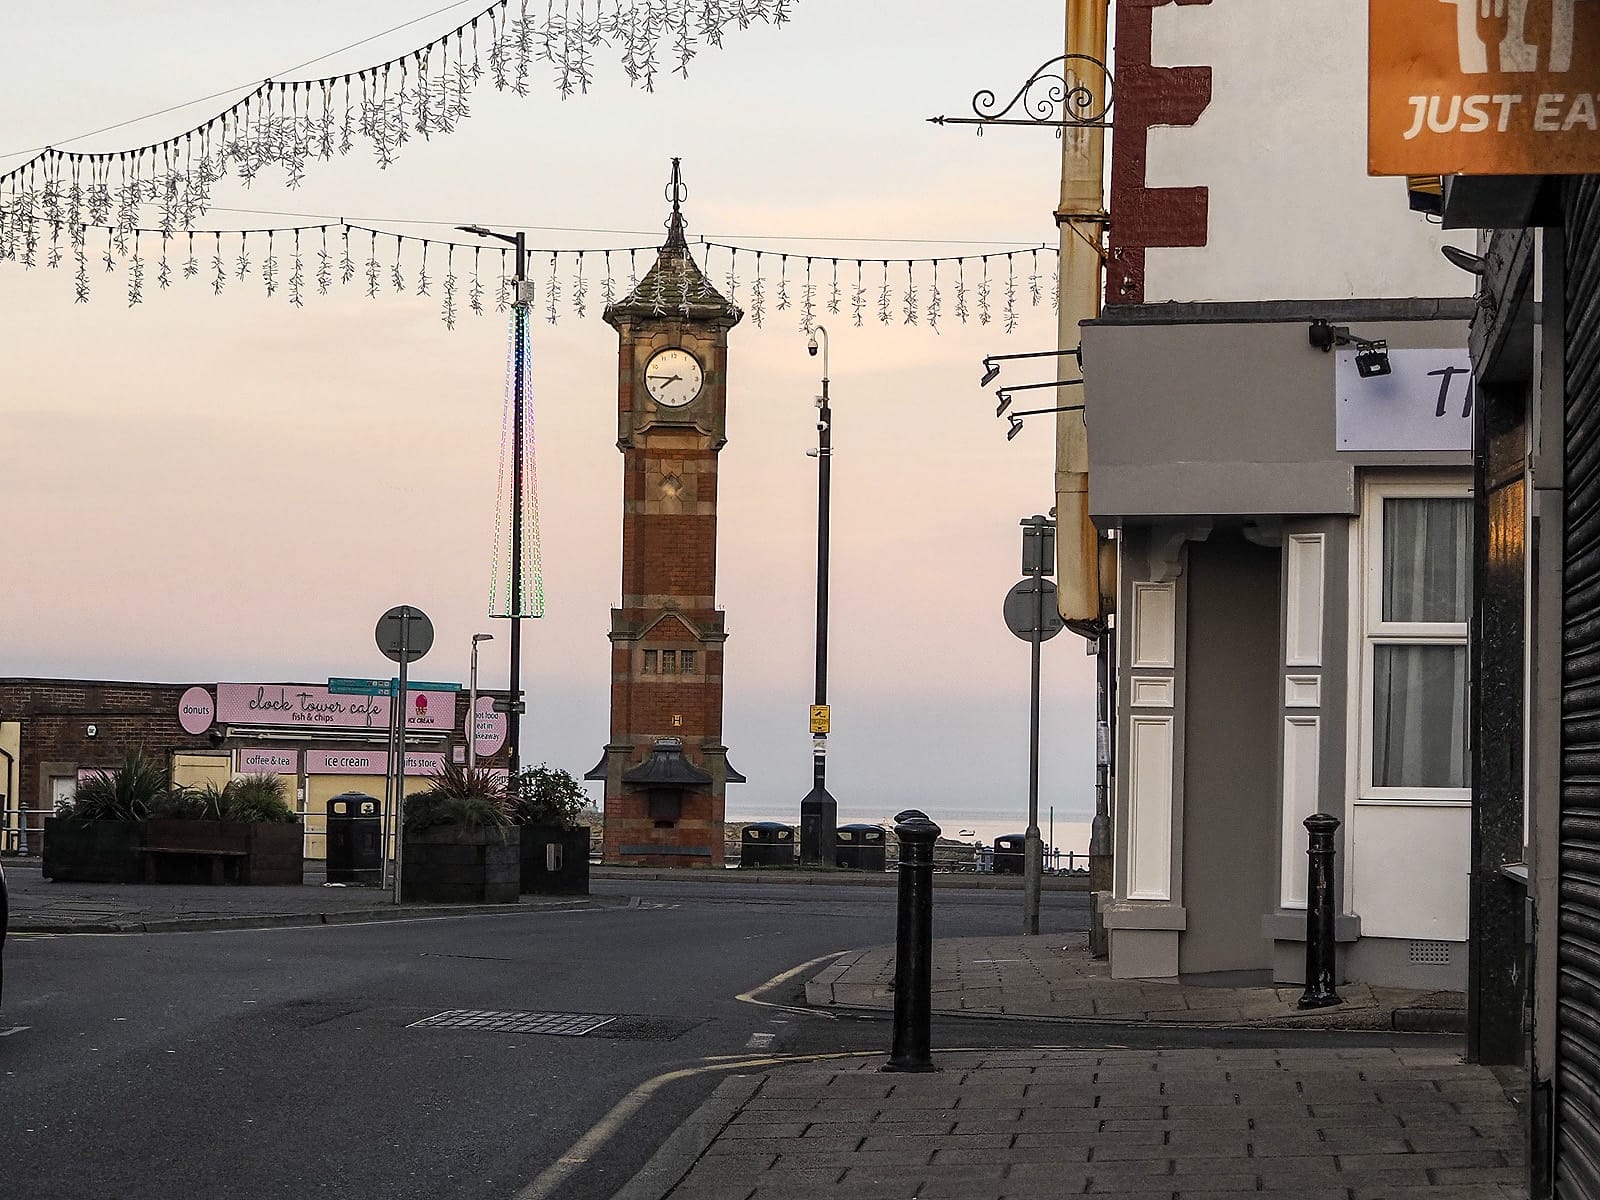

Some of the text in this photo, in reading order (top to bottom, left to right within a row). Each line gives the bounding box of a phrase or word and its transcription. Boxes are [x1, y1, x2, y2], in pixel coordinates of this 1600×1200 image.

[1403, 93, 1600, 140] JUST EA
[183, 705, 210, 715] donuts
[250, 686, 382, 727] clock tower cafe
[292, 713, 305, 721] fish
[314, 713, 334, 722] chips
[485, 711, 499, 719] food
[246, 755, 290, 766] coffee & tea
[325, 755, 369, 767] ice cream
[403, 757, 437, 768] ifts store
